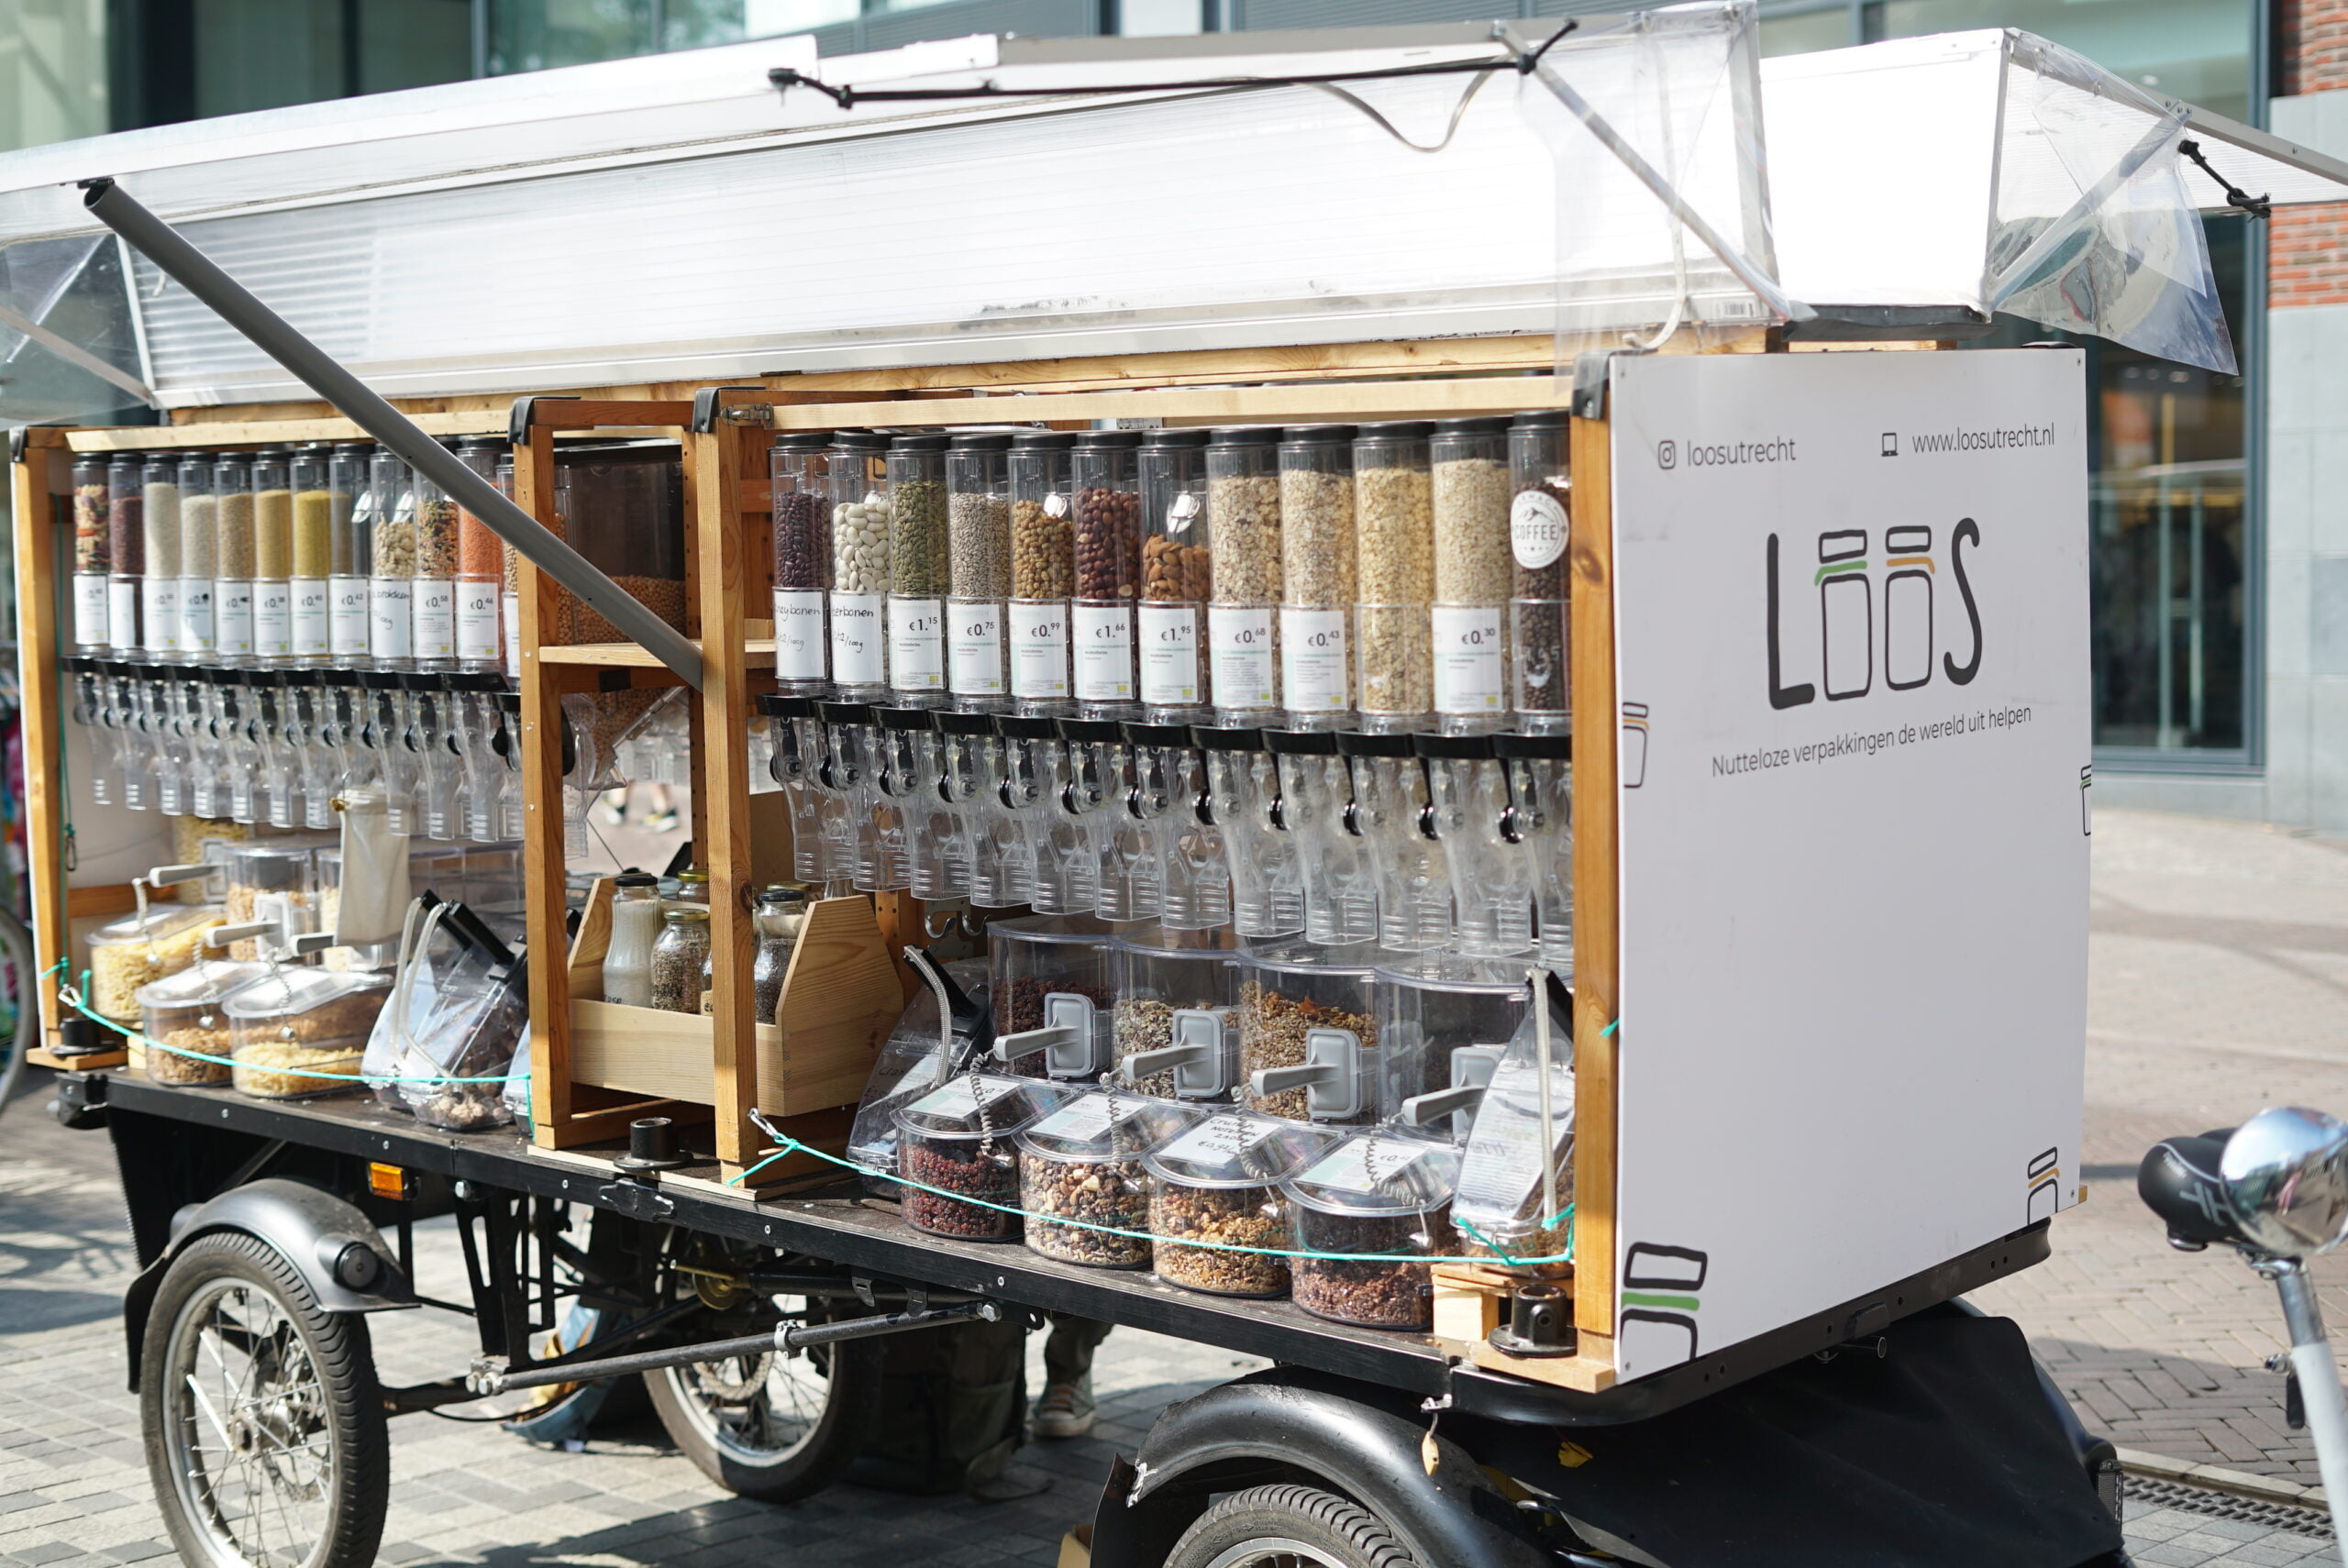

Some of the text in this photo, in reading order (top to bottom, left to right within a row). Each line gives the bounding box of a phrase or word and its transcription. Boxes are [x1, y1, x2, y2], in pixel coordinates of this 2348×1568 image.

[1688, 436, 1797, 467] loosutrecht
[1912, 422, 2054, 453] www.loosutrecht.nl
[1514, 525, 1557, 540] COFFEE
[1712, 706, 2032, 778] Nutteloze verpakkingen de wereld uit helpen
